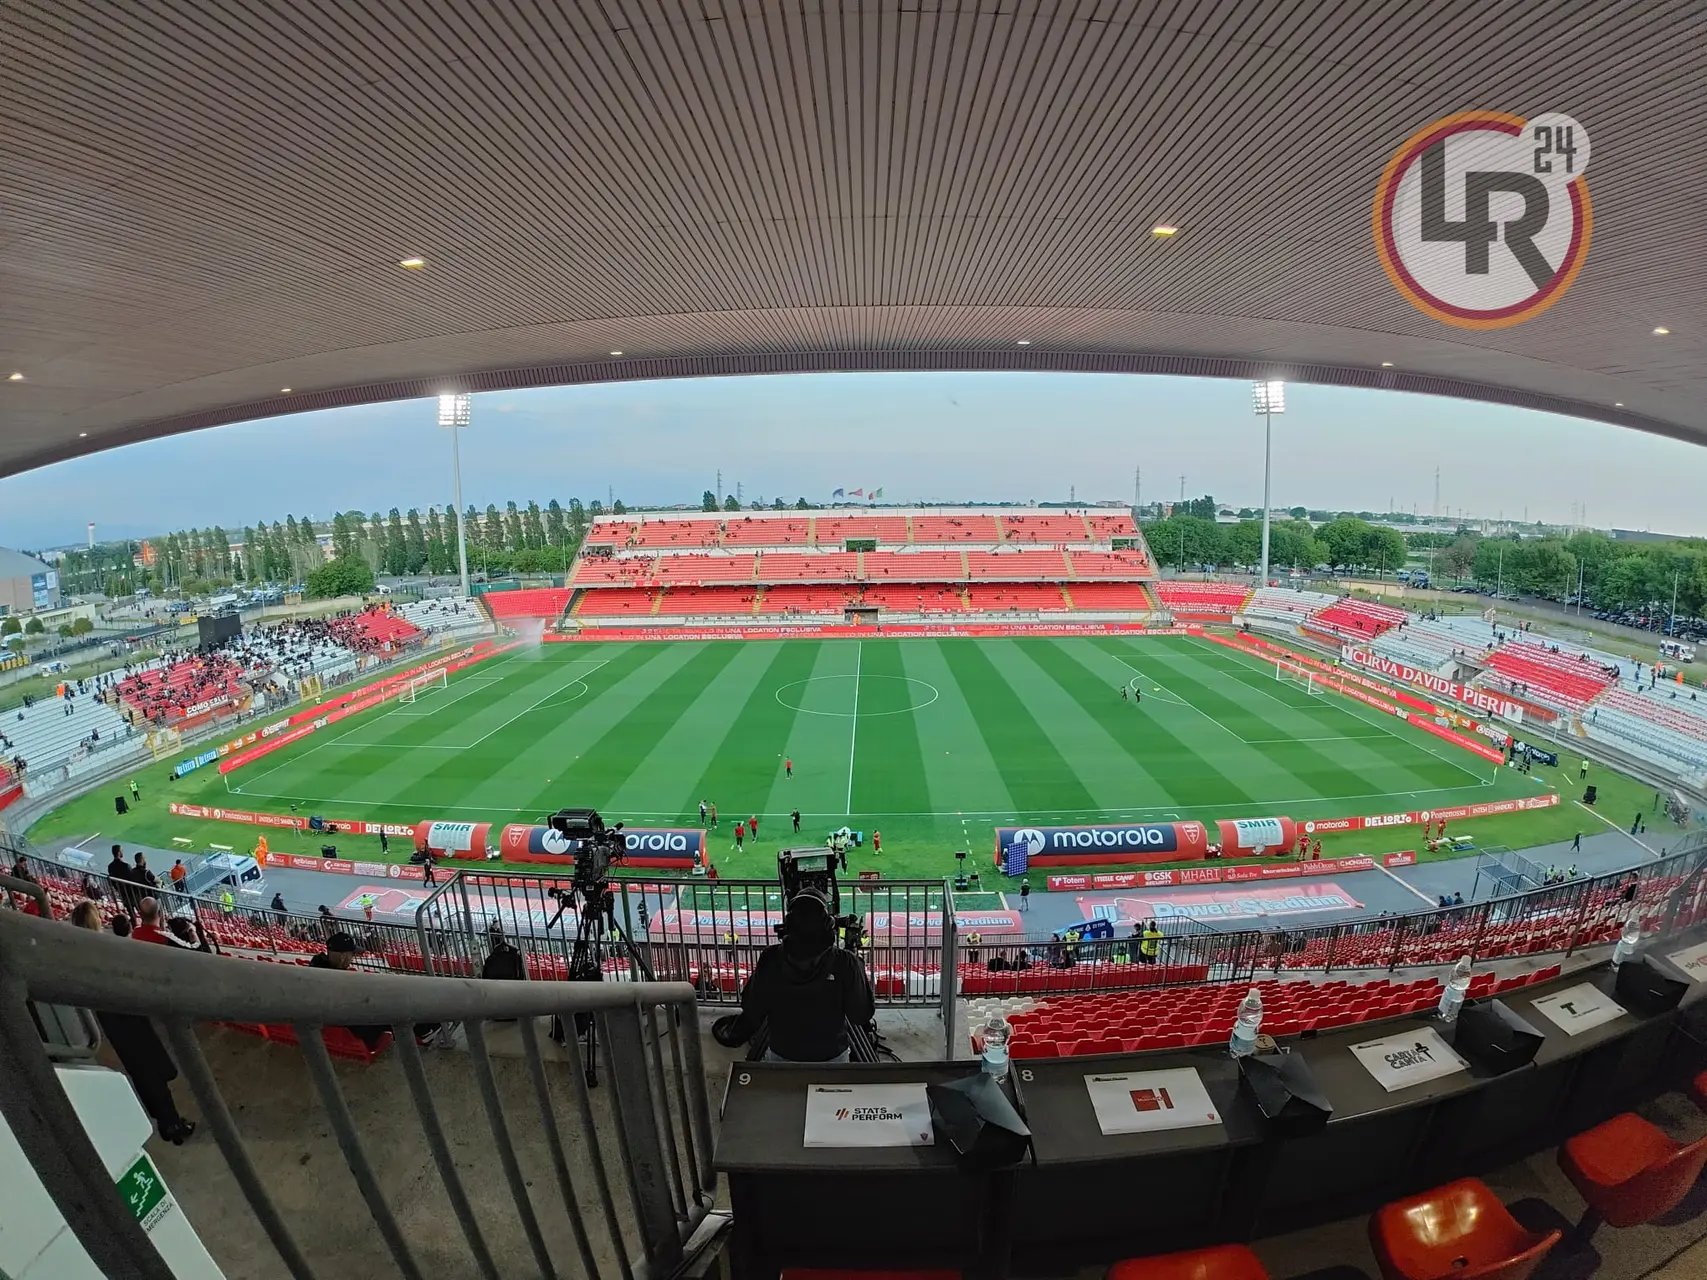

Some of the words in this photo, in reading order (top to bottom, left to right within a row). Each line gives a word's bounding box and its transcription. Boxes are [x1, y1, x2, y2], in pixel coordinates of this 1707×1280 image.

[1332, 667, 1362, 684] LOCATION
[1352, 651, 1398, 676] CURVA
[1402, 667, 1458, 698] DAVIDE
[1463, 688, 1505, 715] PIERI
[434, 822, 472, 832] SMIR
[1237, 818, 1277, 829] SMIR
[1316, 820, 1350, 830] motorola
[1053, 826, 1164, 848] motorola
[1063, 876, 1085, 884] Totem
[1152, 871, 1172, 880] GSK
[1180, 868, 1221, 880] MHART
[1152, 902, 1236, 919] Power
[1236, 895, 1345, 915] Stadium
[956, 916, 1012, 927] Stadium
[738, 1073, 751, 1085] 9
[1022, 1069, 1034, 1082] 8
[851, 1112, 903, 1121] PERFORM
[854, 1107, 888, 1115] STATS
[143, 1207, 160, 1226] SCALA
[146, 1202, 174, 1232] MERGENZA
